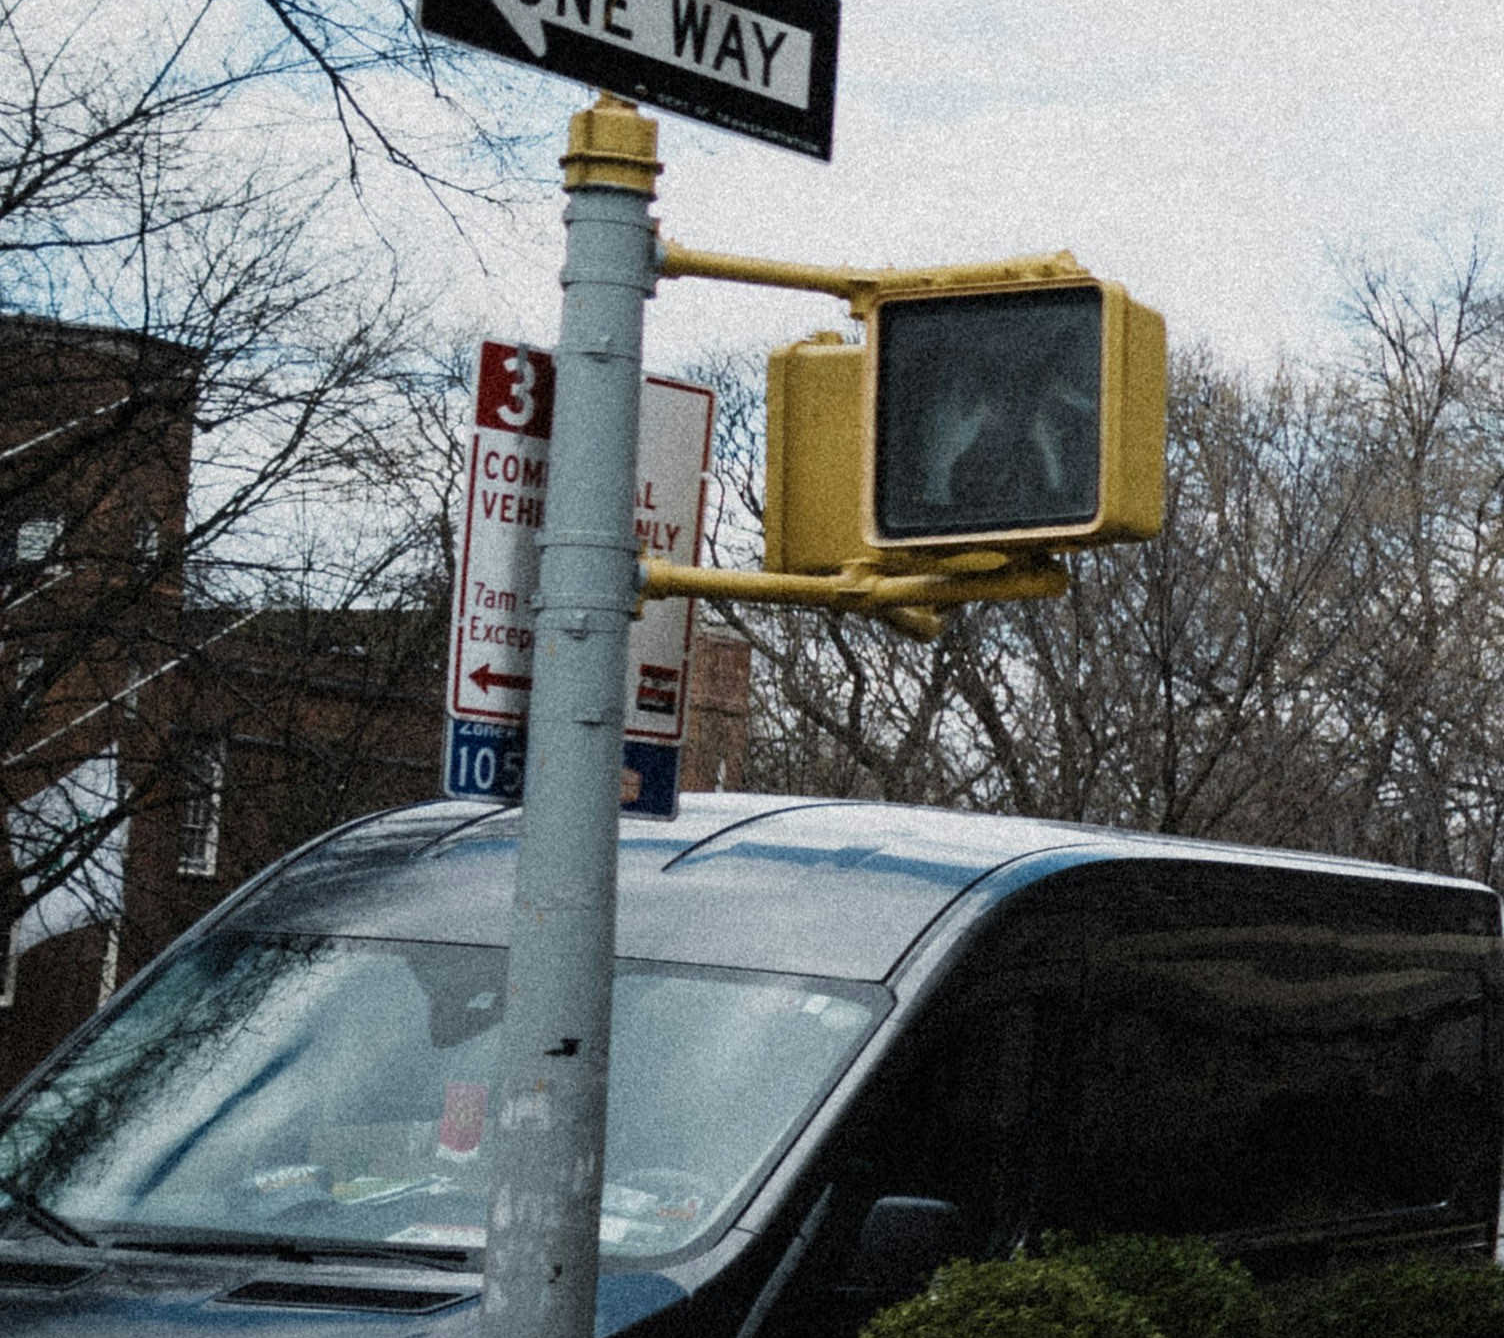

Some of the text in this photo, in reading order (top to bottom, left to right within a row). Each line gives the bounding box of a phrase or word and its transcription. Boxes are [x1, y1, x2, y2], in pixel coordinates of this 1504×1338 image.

[497, 357, 535, 428] 3
[484, 450, 549, 489] COM
[482, 489, 681, 552] VEHI NLY
[474, 581, 517, 613] 7am
[469, 615, 535, 654] Excep
